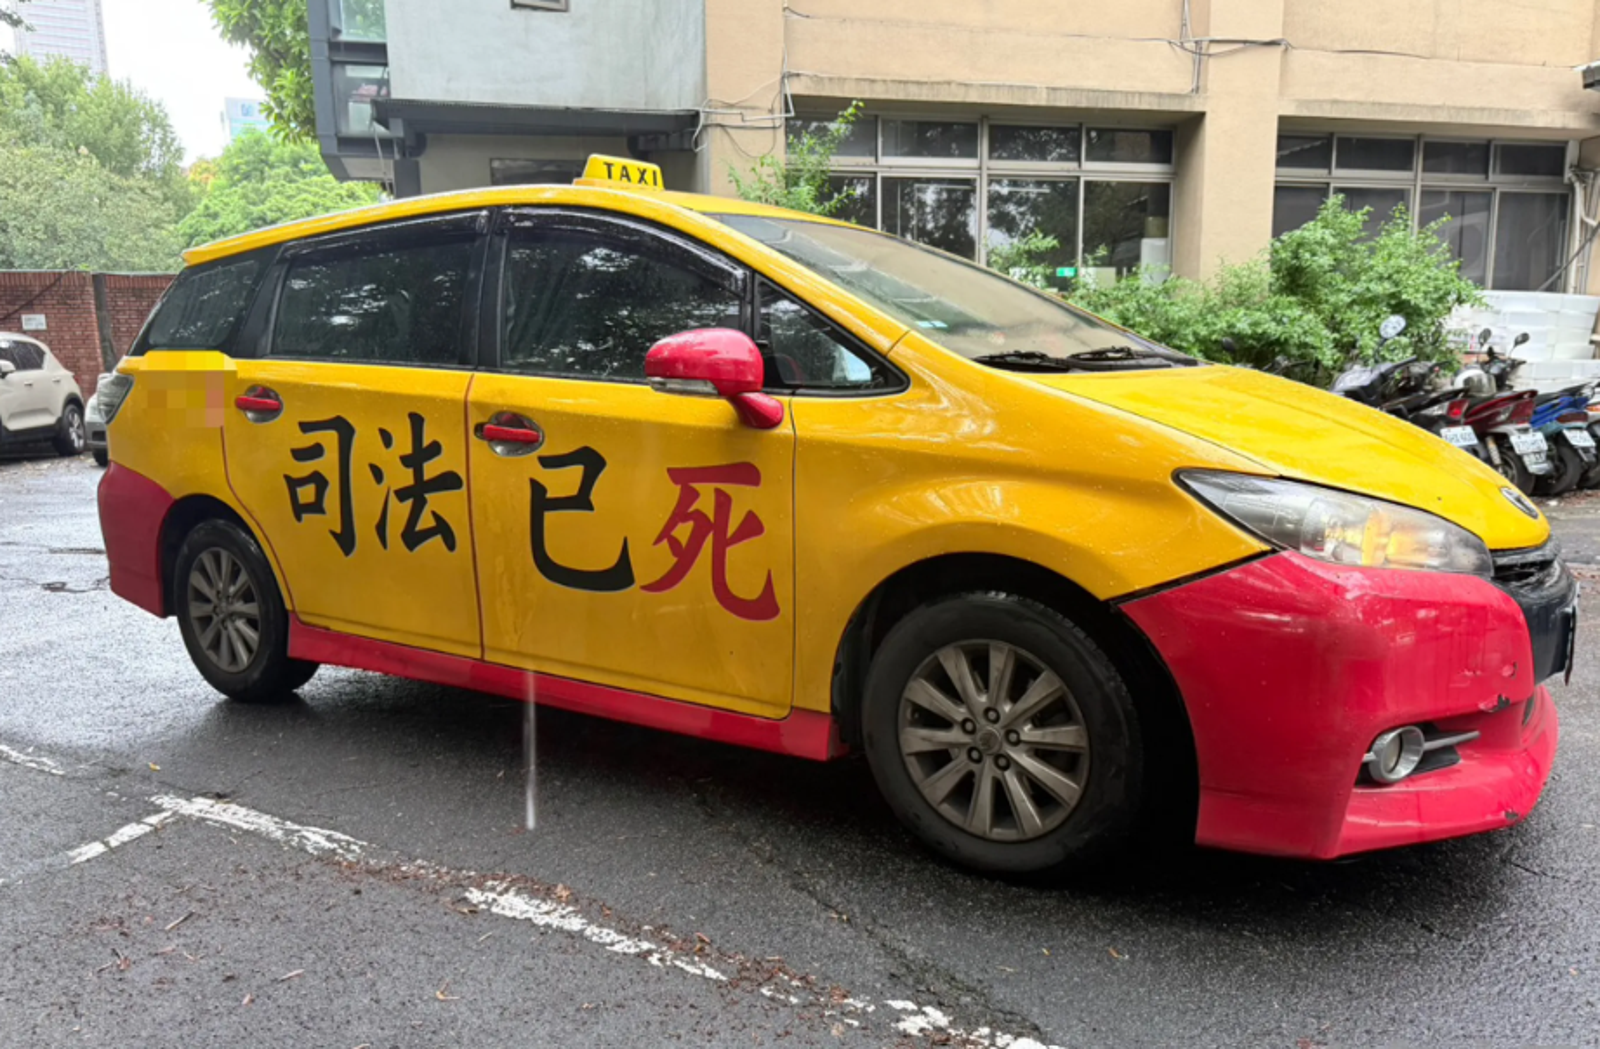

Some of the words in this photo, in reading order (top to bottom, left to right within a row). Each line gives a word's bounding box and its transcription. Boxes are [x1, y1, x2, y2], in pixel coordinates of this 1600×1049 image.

[603, 161, 658, 187] TAXI
[283, 411, 780, 621] 司法已死
